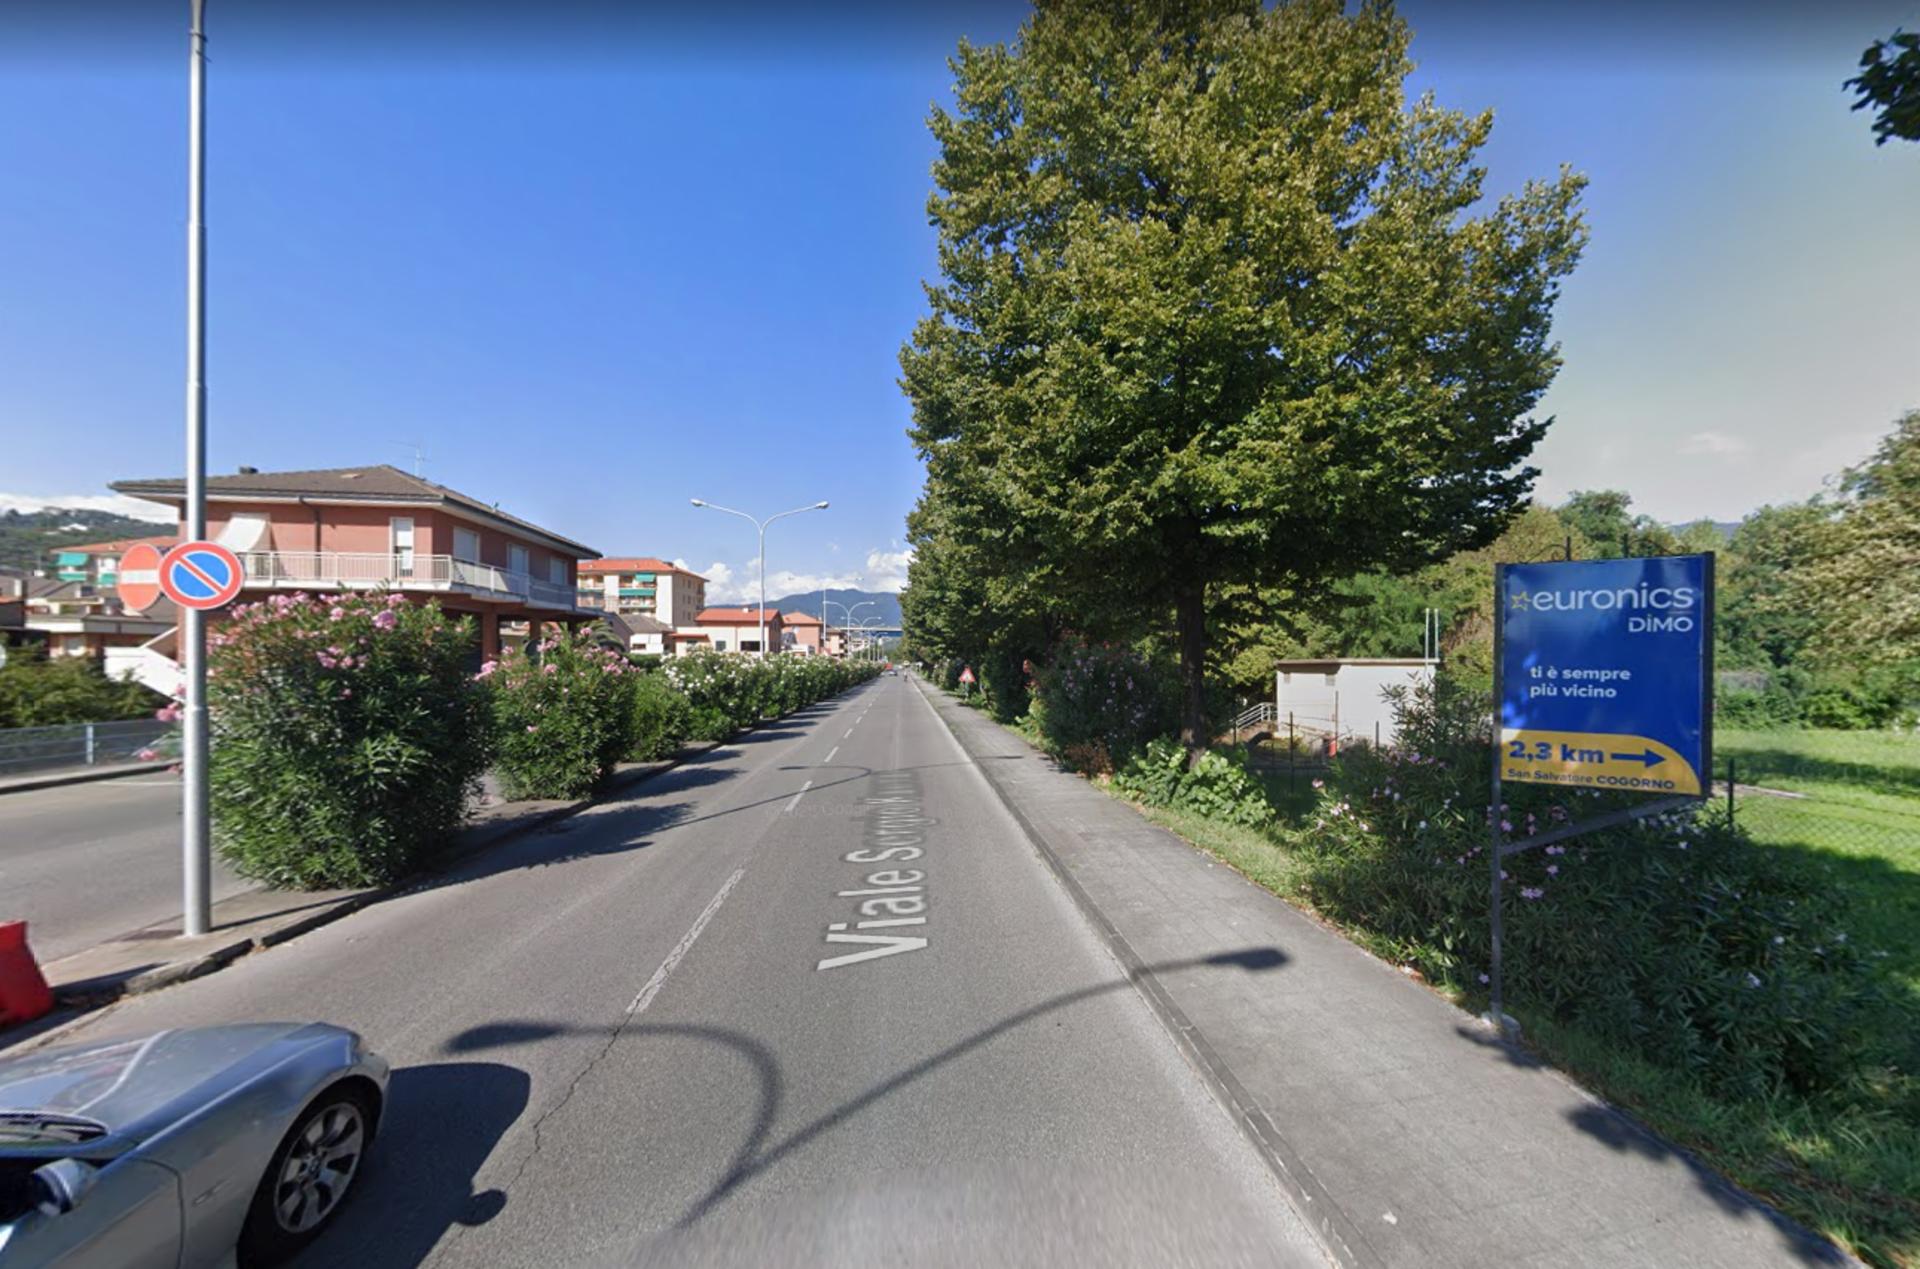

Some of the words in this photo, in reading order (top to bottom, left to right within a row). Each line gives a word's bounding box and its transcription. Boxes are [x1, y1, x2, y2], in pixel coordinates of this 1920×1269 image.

[1532, 582, 1695, 611] euronics
[1530, 665, 1543, 678] ti
[1547, 666, 1558, 679] è
[1562, 668, 1631, 682] sempre
[1530, 683, 1557, 698] più
[1562, 684, 1617, 698] vicino
[1509, 740, 1552, 761] 2,3
[1561, 743, 1604, 763] km
[1507, 768, 1531, 778] San
[1534, 770, 1593, 783] Salvatore
[1596, 775, 1675, 789] COGORNO
